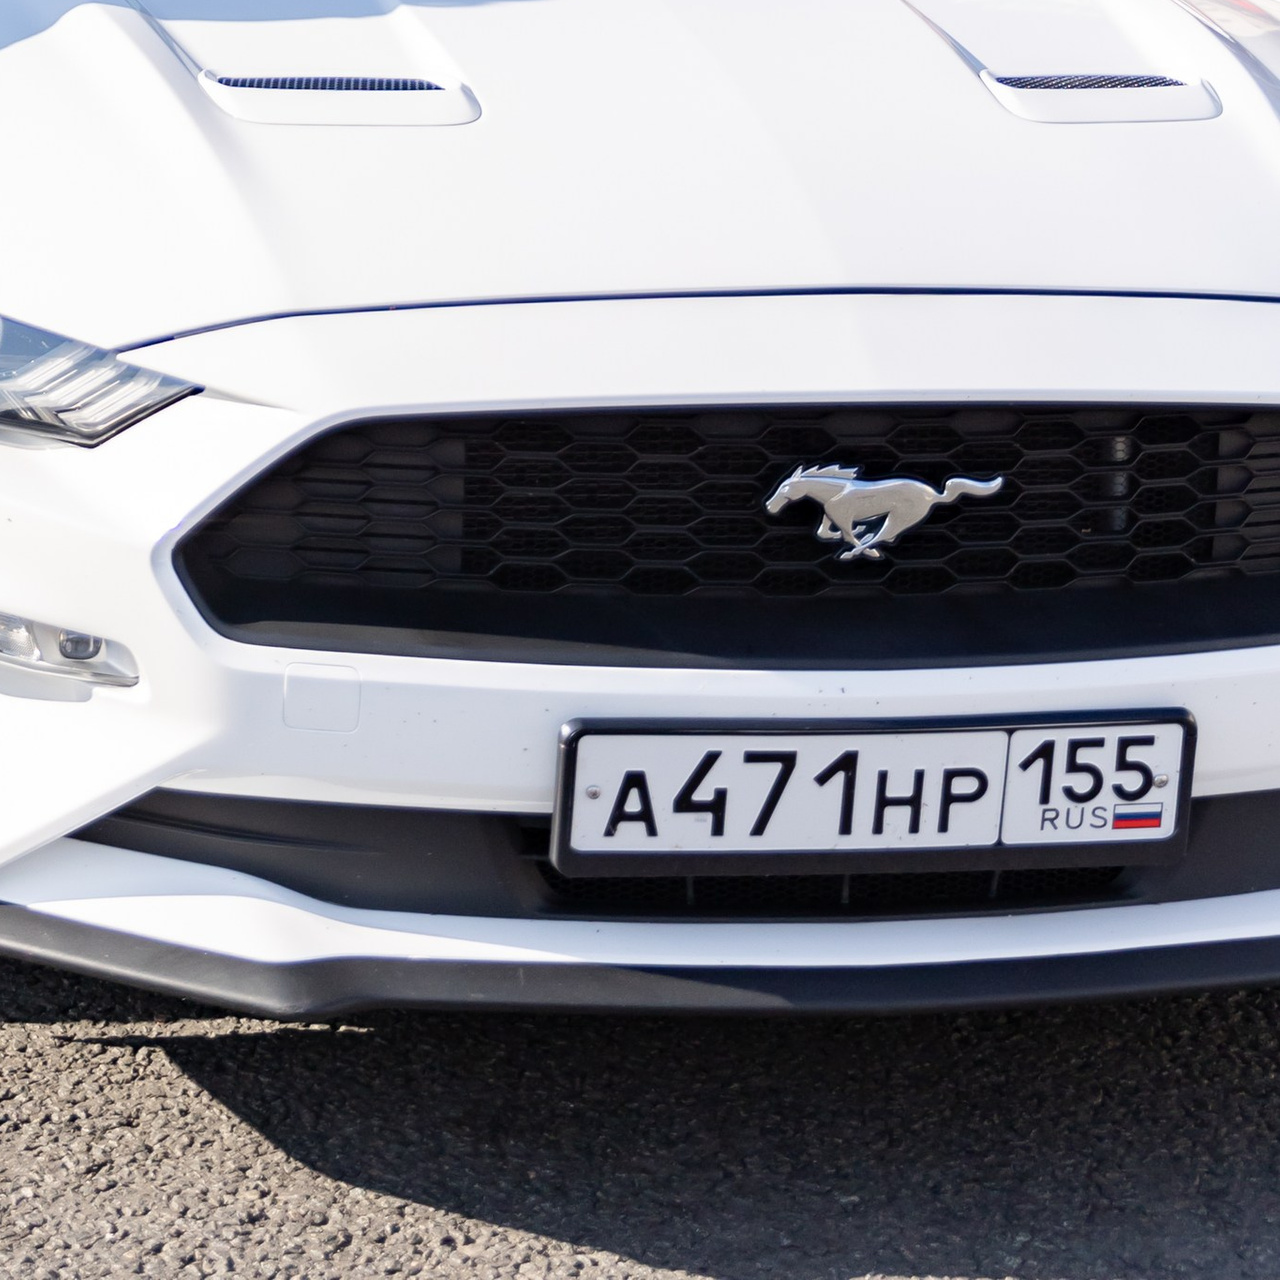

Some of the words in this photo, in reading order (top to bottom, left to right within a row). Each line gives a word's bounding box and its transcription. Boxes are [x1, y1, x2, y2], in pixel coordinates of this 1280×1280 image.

[603, 750, 989, 837] А471НР
[1018, 735, 1155, 805] 155
[1040, 806, 1108, 831] RUS
